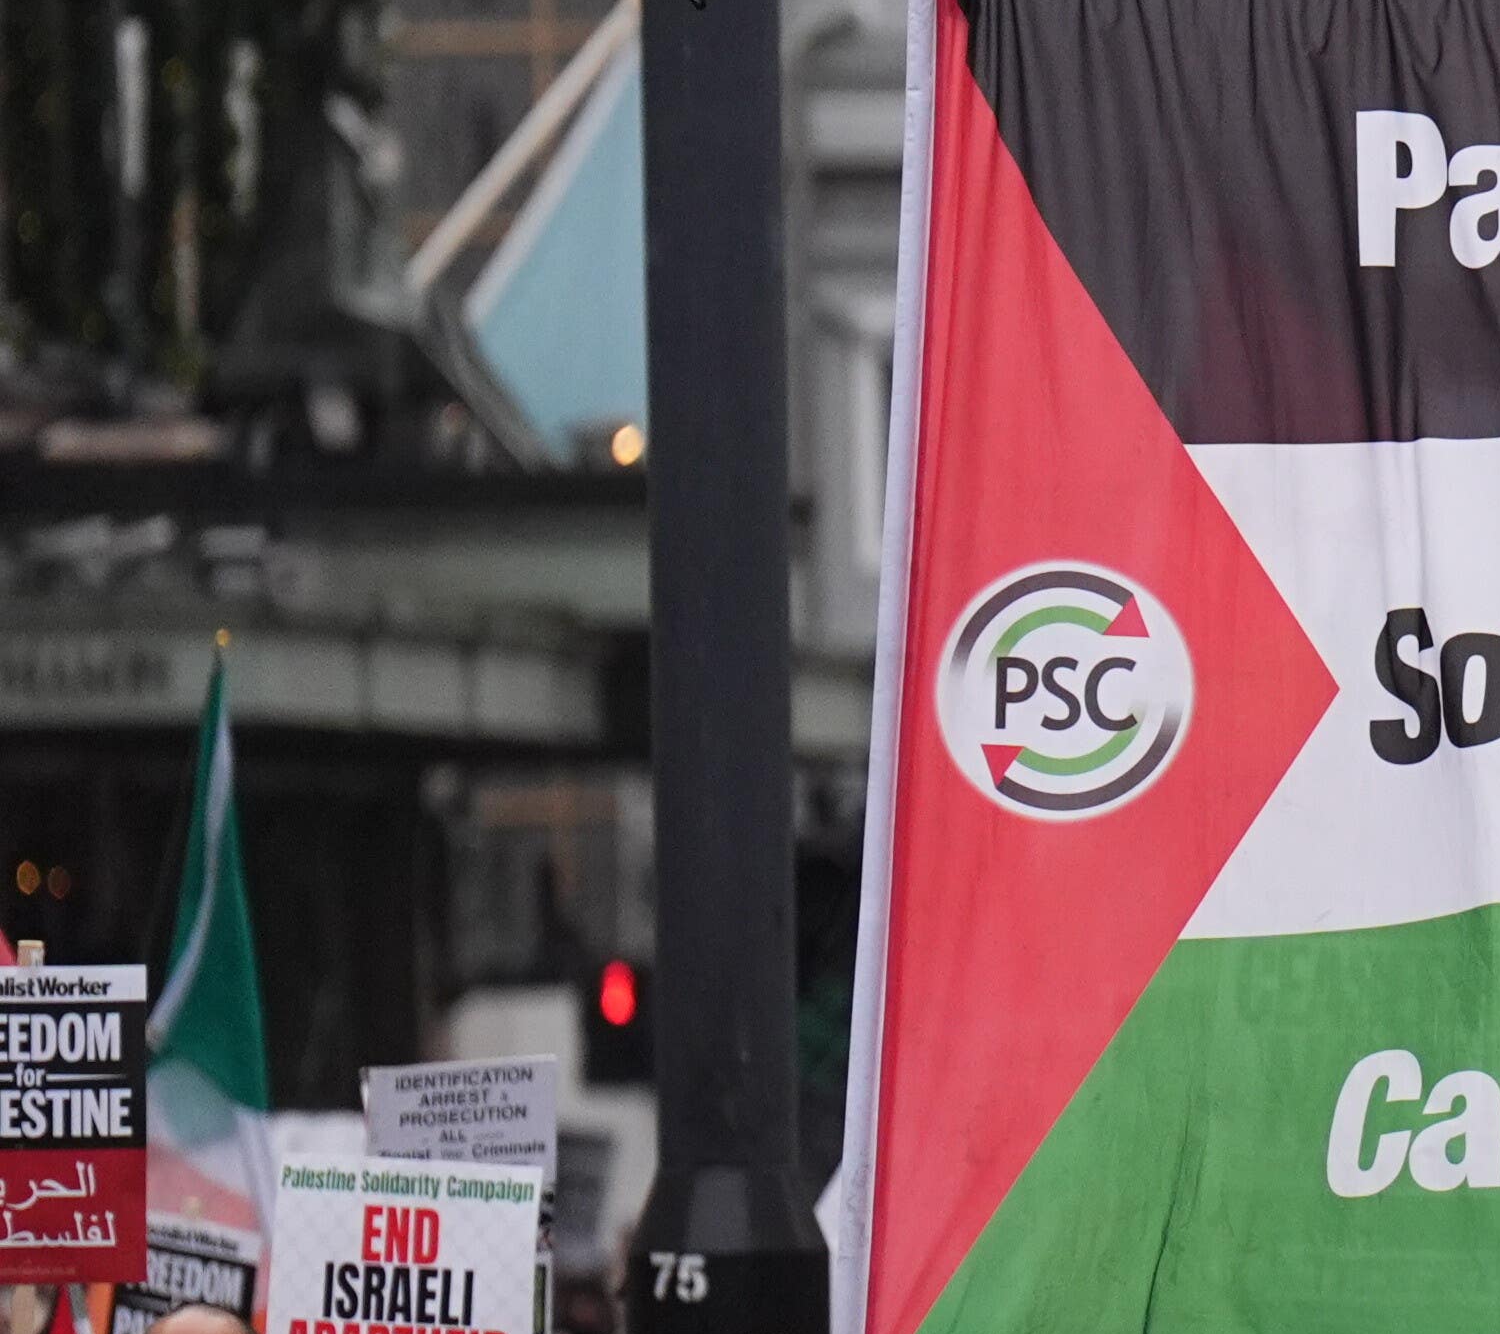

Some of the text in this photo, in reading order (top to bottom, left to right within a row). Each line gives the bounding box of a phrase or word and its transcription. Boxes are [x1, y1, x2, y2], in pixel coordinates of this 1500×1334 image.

[994, 655, 1137, 731] PSC
[37, 976, 111, 996] Worker
[0, 1013, 121, 1062] EDOM
[15, 1062, 46, 1087] for
[395, 1067, 534, 1091] IDENTIFICATION
[0, 1089, 133, 1139] ESTINE
[399, 1105, 528, 1127] PROSECUTION
[419, 1089, 489, 1107] ARREST
[281, 1165, 535, 1204] Palestine Solidarity Campaign
[361, 1204, 440, 1265] END
[322, 1261, 475, 1326] ISRAELI
[648, 1251, 708, 1303] 75
